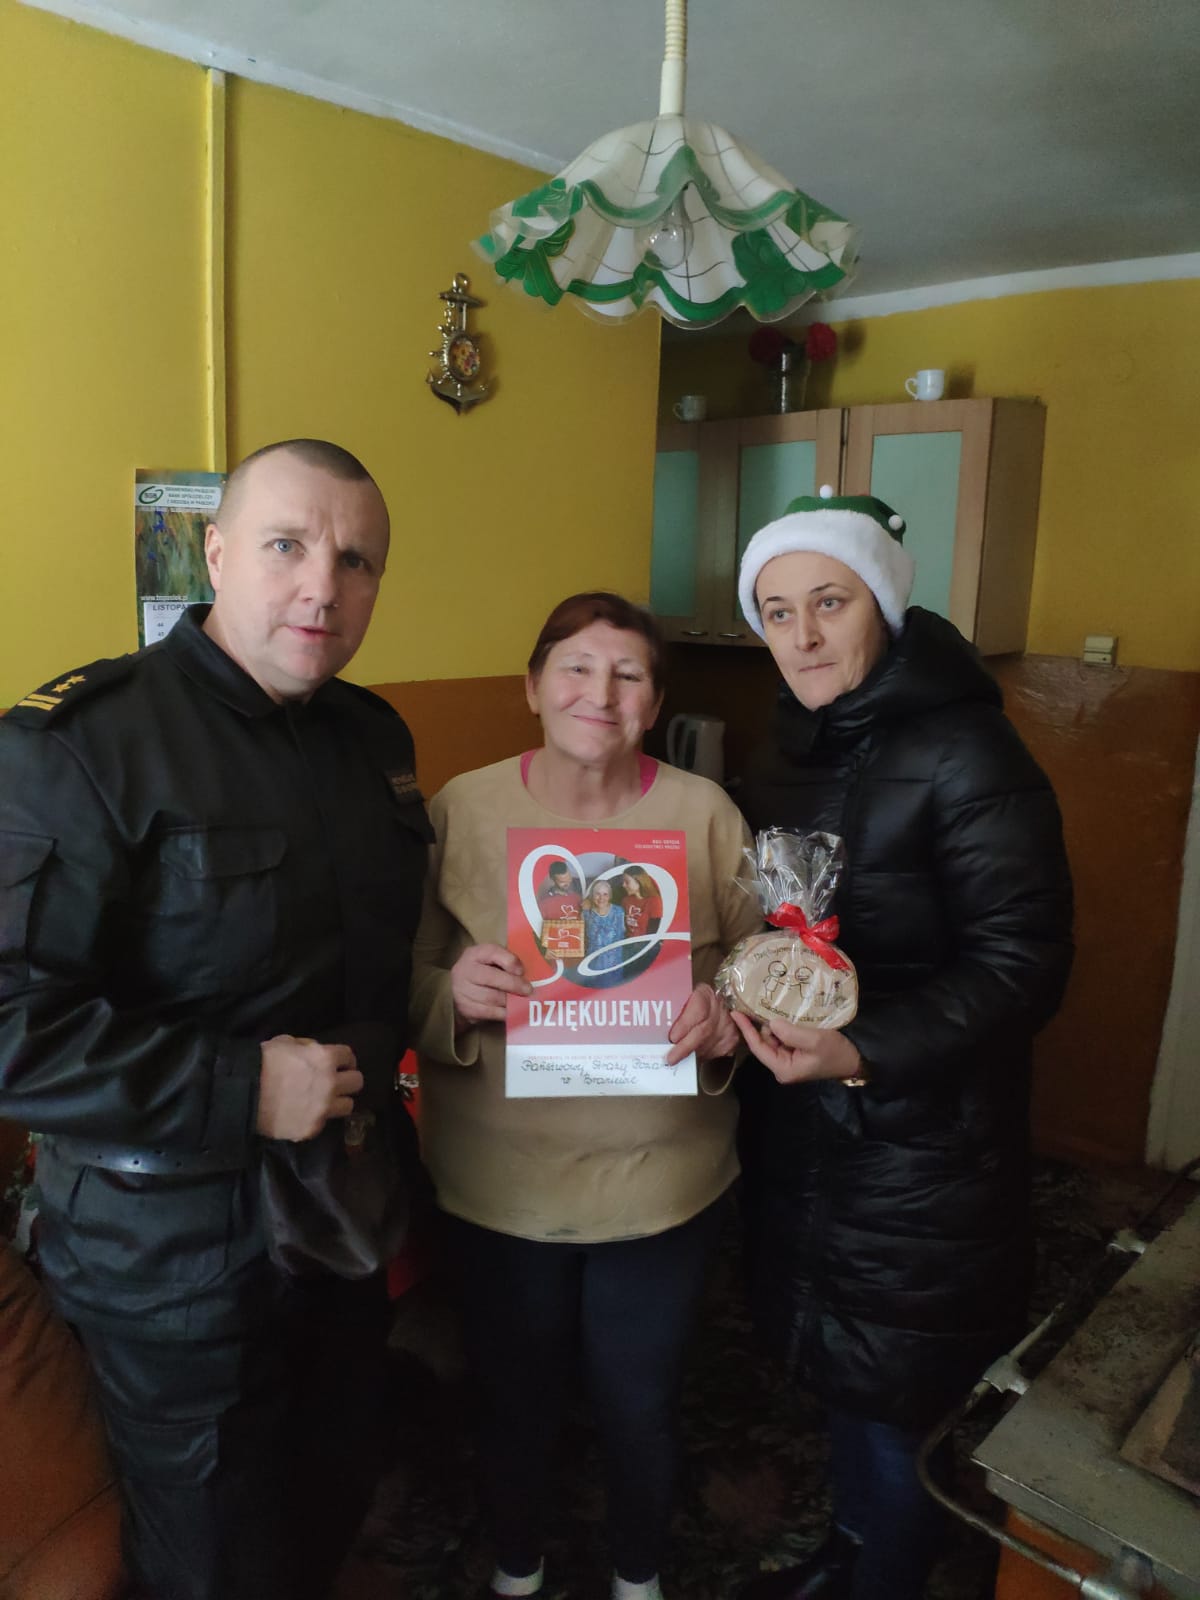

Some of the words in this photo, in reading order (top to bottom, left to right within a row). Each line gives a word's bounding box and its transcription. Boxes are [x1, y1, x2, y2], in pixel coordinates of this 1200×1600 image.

[152, 603, 187, 611] LISTOPA
[528, 999, 673, 1032] DZIĘKUJEMY!
[560, 1076, 572, 1085] w
